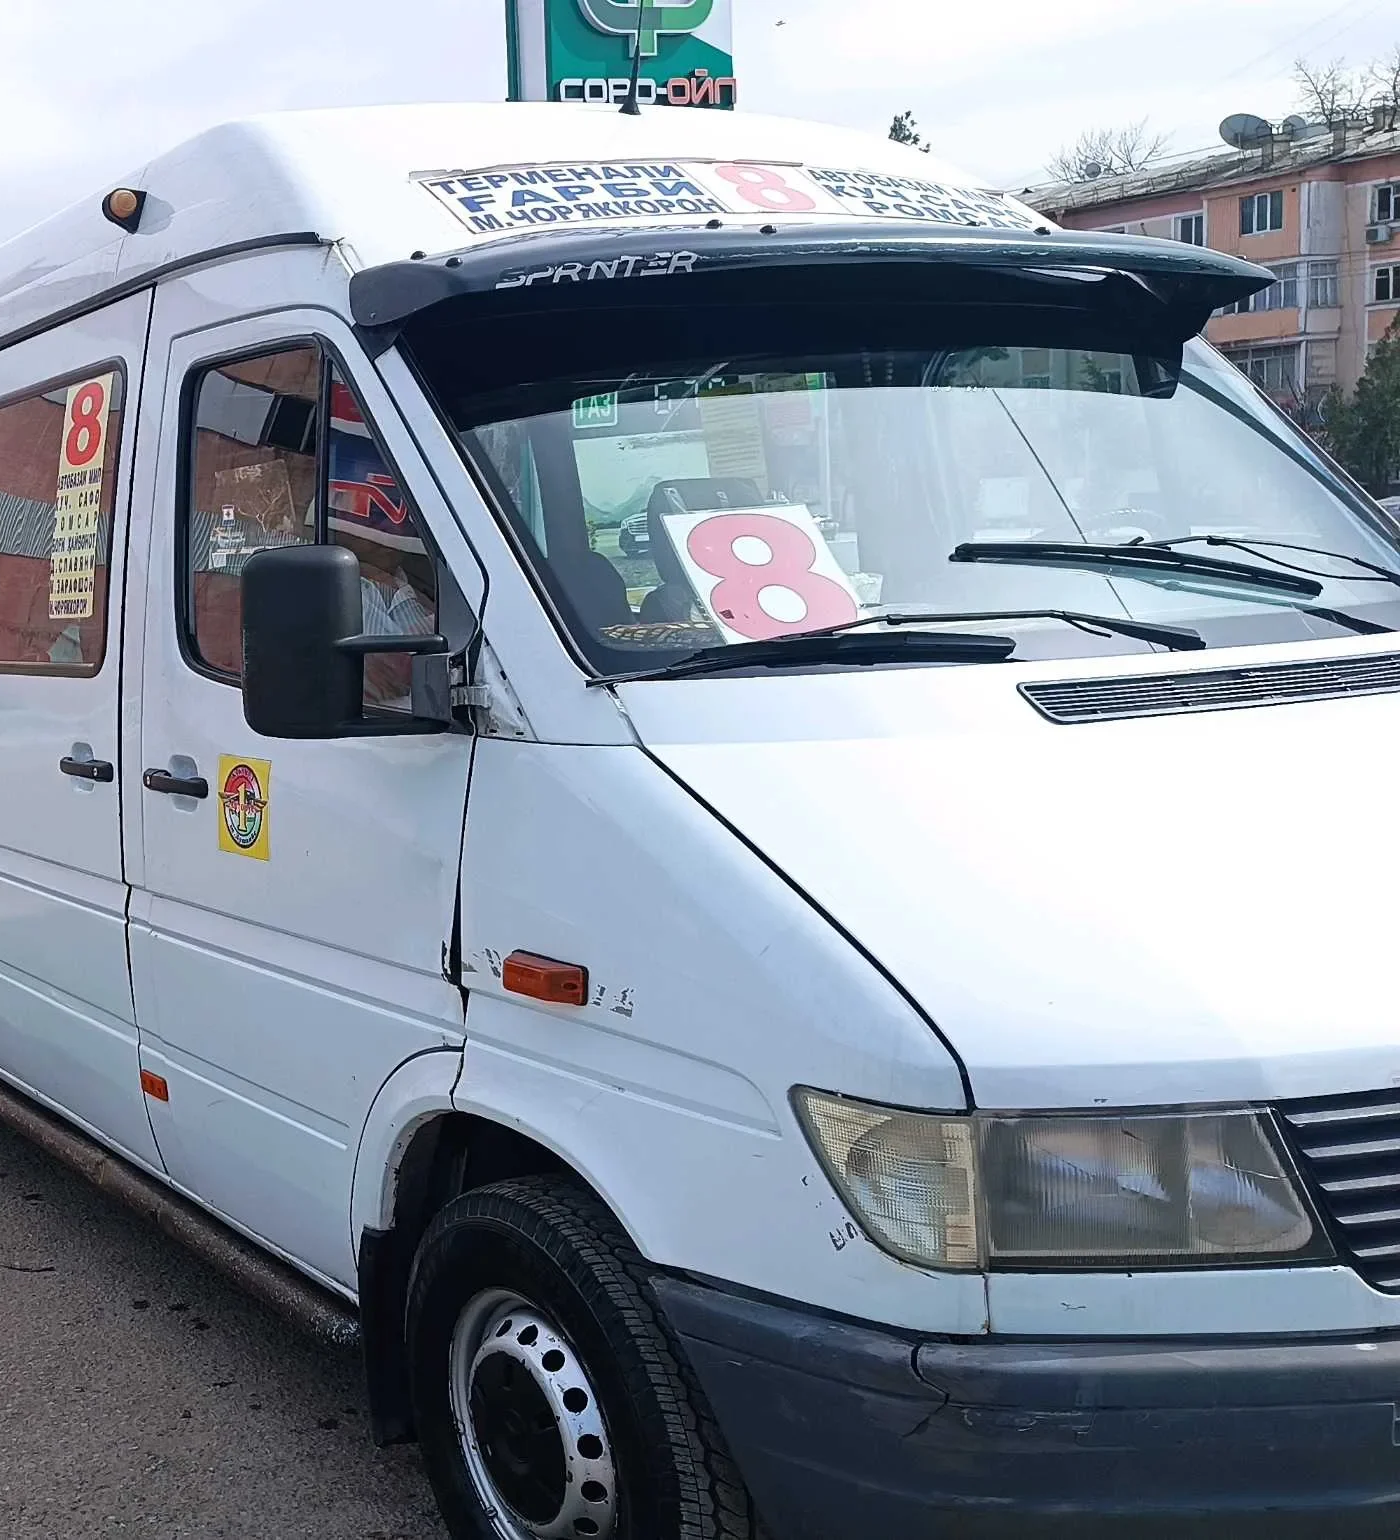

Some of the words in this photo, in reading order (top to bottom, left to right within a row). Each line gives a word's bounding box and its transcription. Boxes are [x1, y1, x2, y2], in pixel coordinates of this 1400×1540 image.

[429, 164, 685, 195] ТЕРМЕНАЛИ
[714, 165, 816, 212] 8
[495, 250, 699, 290] SPRNTER
[65, 382, 105, 466] 8
[687, 513, 858, 641] 8
